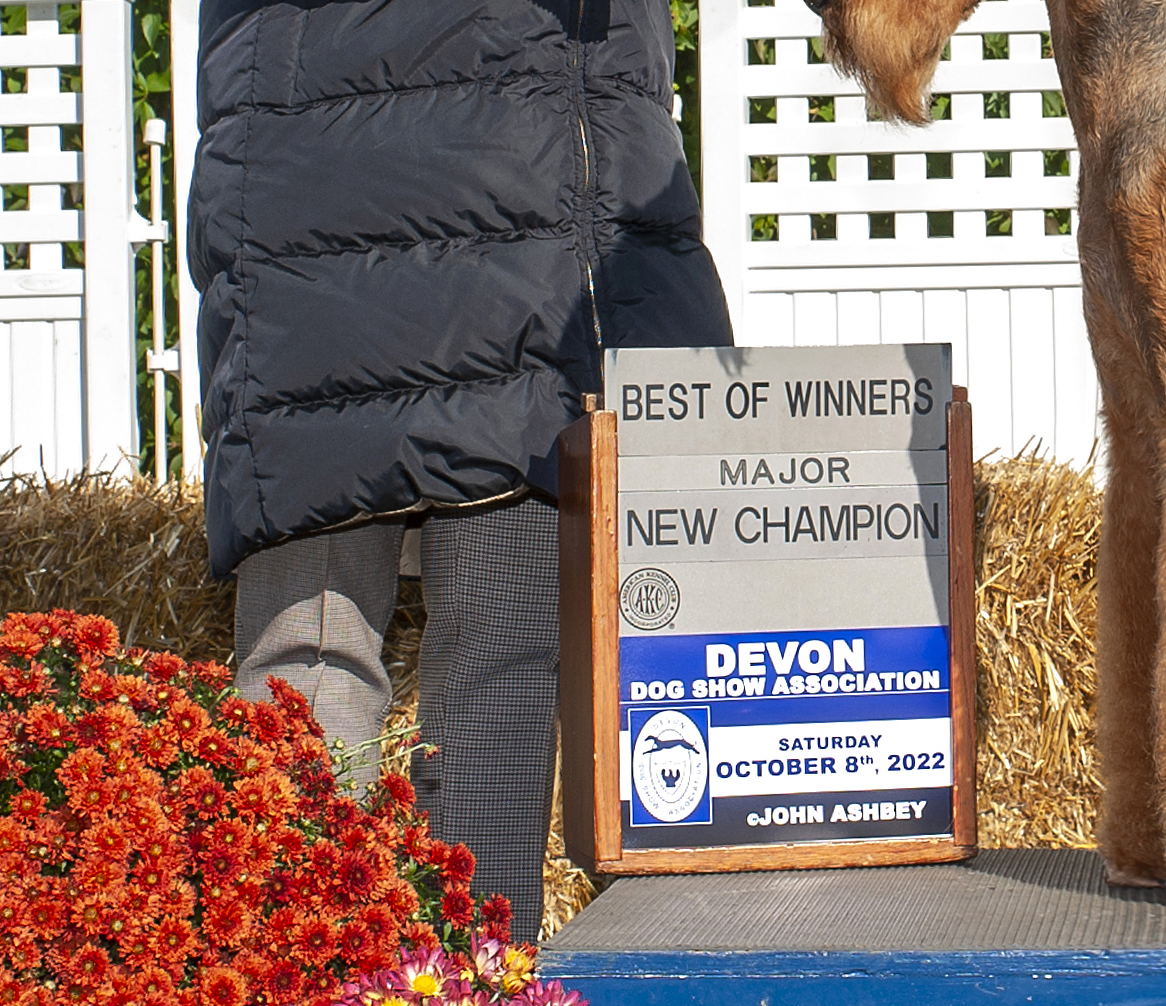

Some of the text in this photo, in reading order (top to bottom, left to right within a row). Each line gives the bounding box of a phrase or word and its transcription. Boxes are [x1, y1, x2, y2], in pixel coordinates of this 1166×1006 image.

[622, 377, 934, 421] BEST OF WINNERS
[720, 457, 850, 485] MAJOR
[627, 502, 939, 546] NEW CHAMPION
[706, 639, 865, 678] DEVON
[630, 670, 940, 700] DOG SHOW ASSOCIATION
[778, 734, 883, 752] SATURDAY
[716, 752, 945, 779] OCTOBER 8th, 2022
[829, 800, 927, 823] ASHBEY
